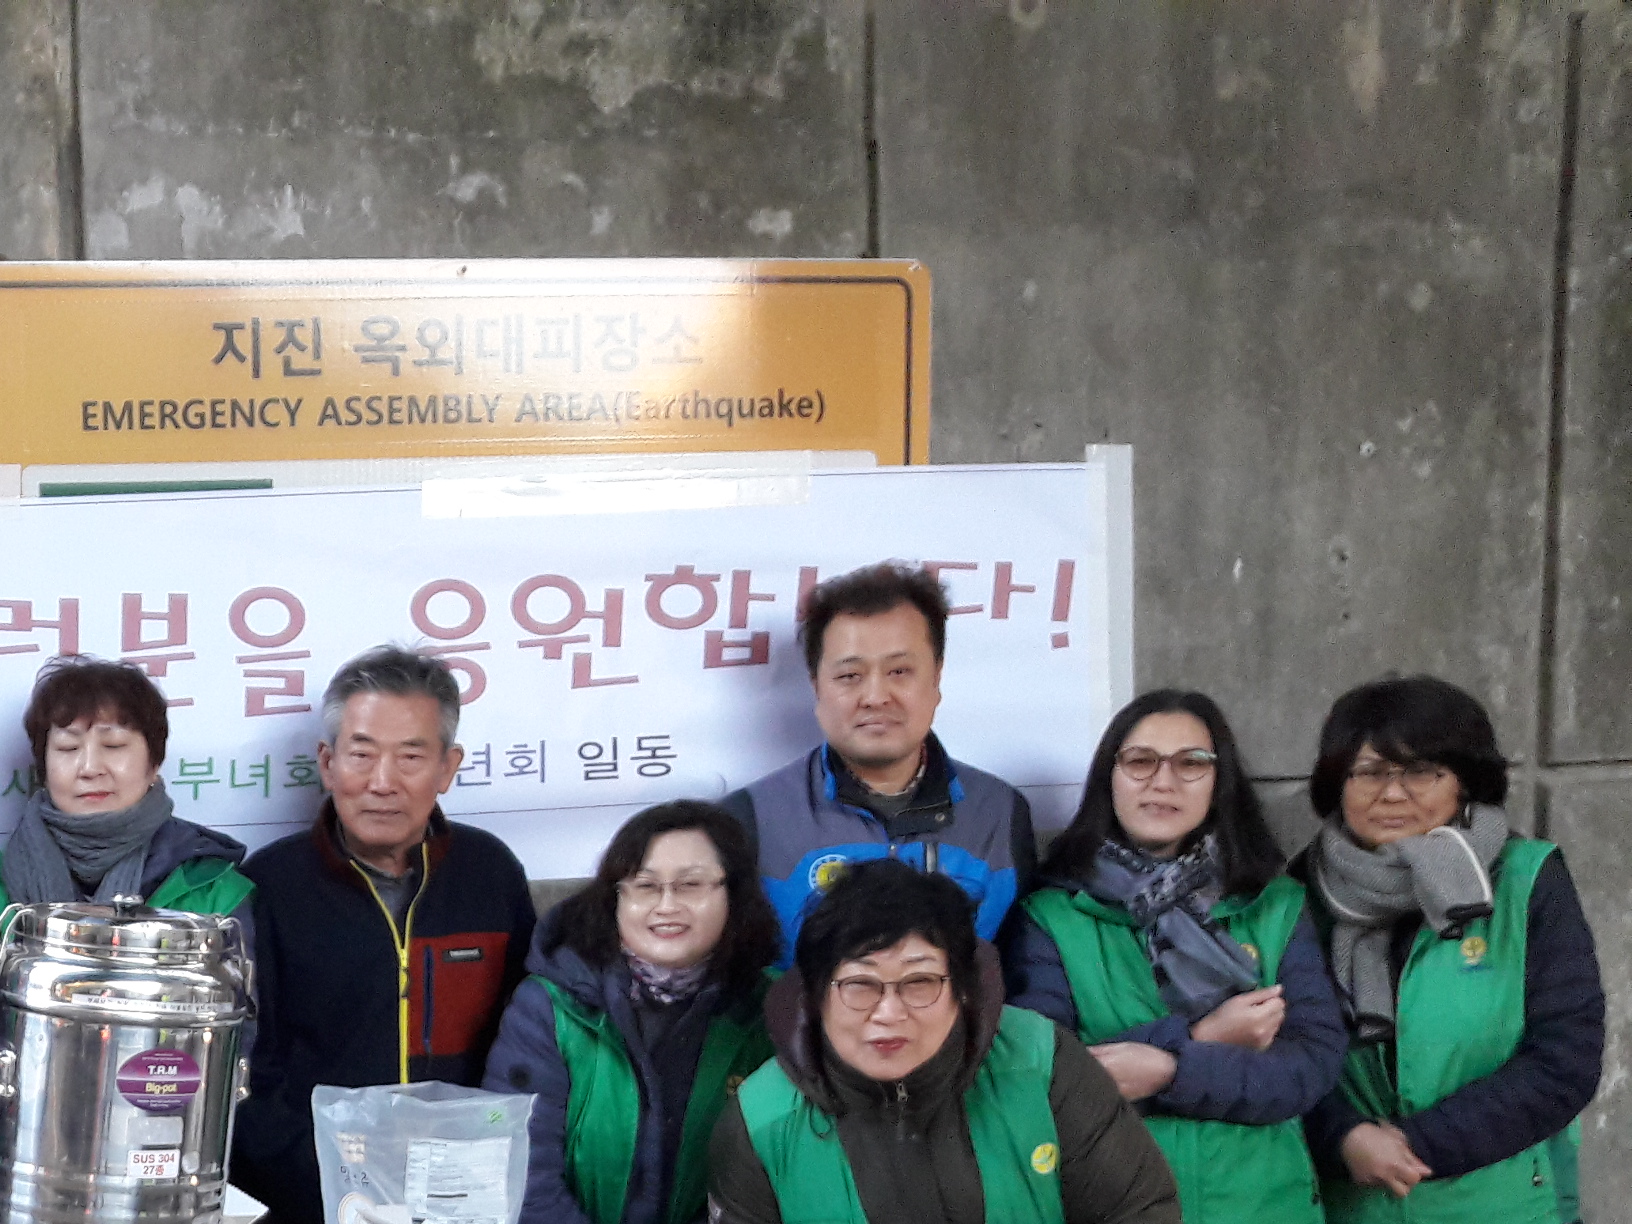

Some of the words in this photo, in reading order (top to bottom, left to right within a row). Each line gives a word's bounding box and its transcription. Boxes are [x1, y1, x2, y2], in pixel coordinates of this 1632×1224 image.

[211, 317, 322, 379] 지진
[353, 312, 704, 378] 옥외대피장소
[82, 398, 304, 431] EMERGENCY
[317, 393, 503, 427] ASSEMBLY
[410, 558, 1076, 707] 응원합다!
[577, 734, 678, 781] 일동
[133, 1154, 155, 1164] SUS
[158, 1153, 175, 1163] 304
